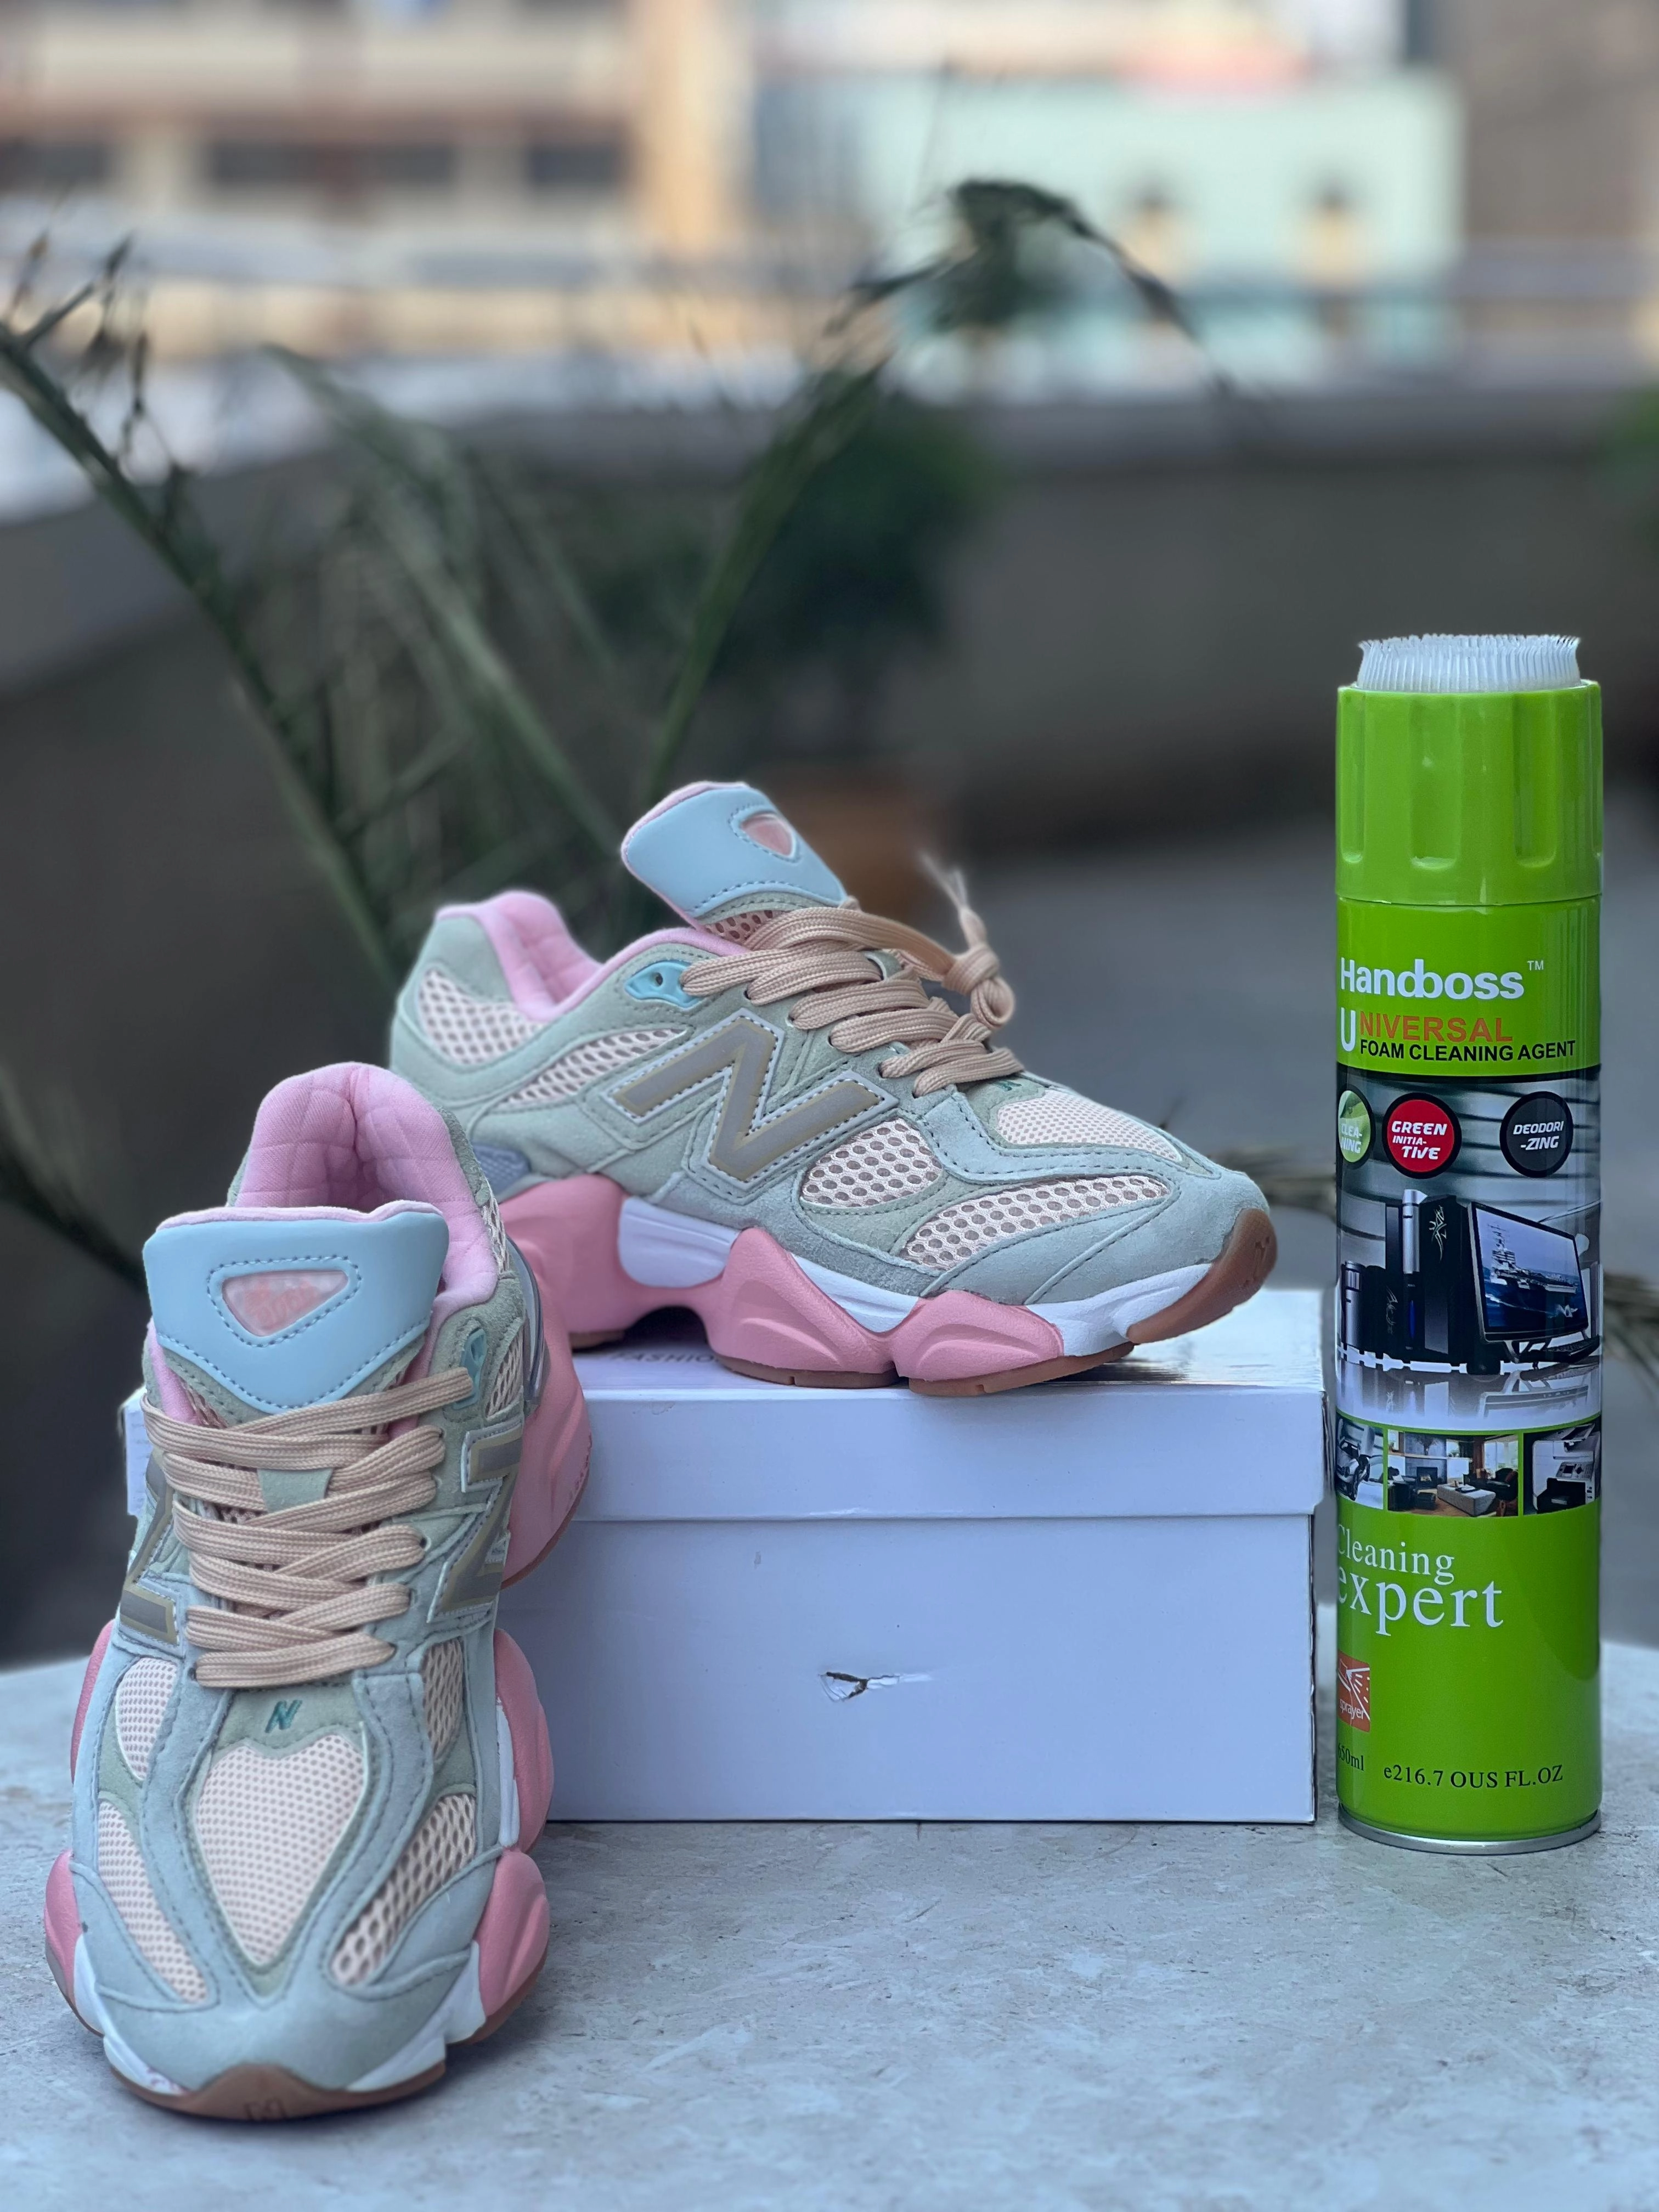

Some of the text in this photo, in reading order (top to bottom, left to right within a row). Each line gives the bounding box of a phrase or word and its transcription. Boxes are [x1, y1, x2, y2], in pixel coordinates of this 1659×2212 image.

[1340, 957, 1525, 1000] Handboss
[1361, 1039, 1576, 1062] FOAM CLEANING AGENT
[1391, 1120, 1447, 1136] GREEN
[1513, 1120, 1564, 1136] DEODORI
[1392, 1135, 1427, 1146] INITIA-
[1520, 1135, 1560, 1151] -ZING
[1401, 1146, 1441, 1160] TIVE
[1338, 1524, 1455, 1585] Cleaning
[1338, 1566, 1504, 1637] expert
[1339, 1698, 1364, 1720] sprayer
[1450, 1770, 1498, 1789] OUS
